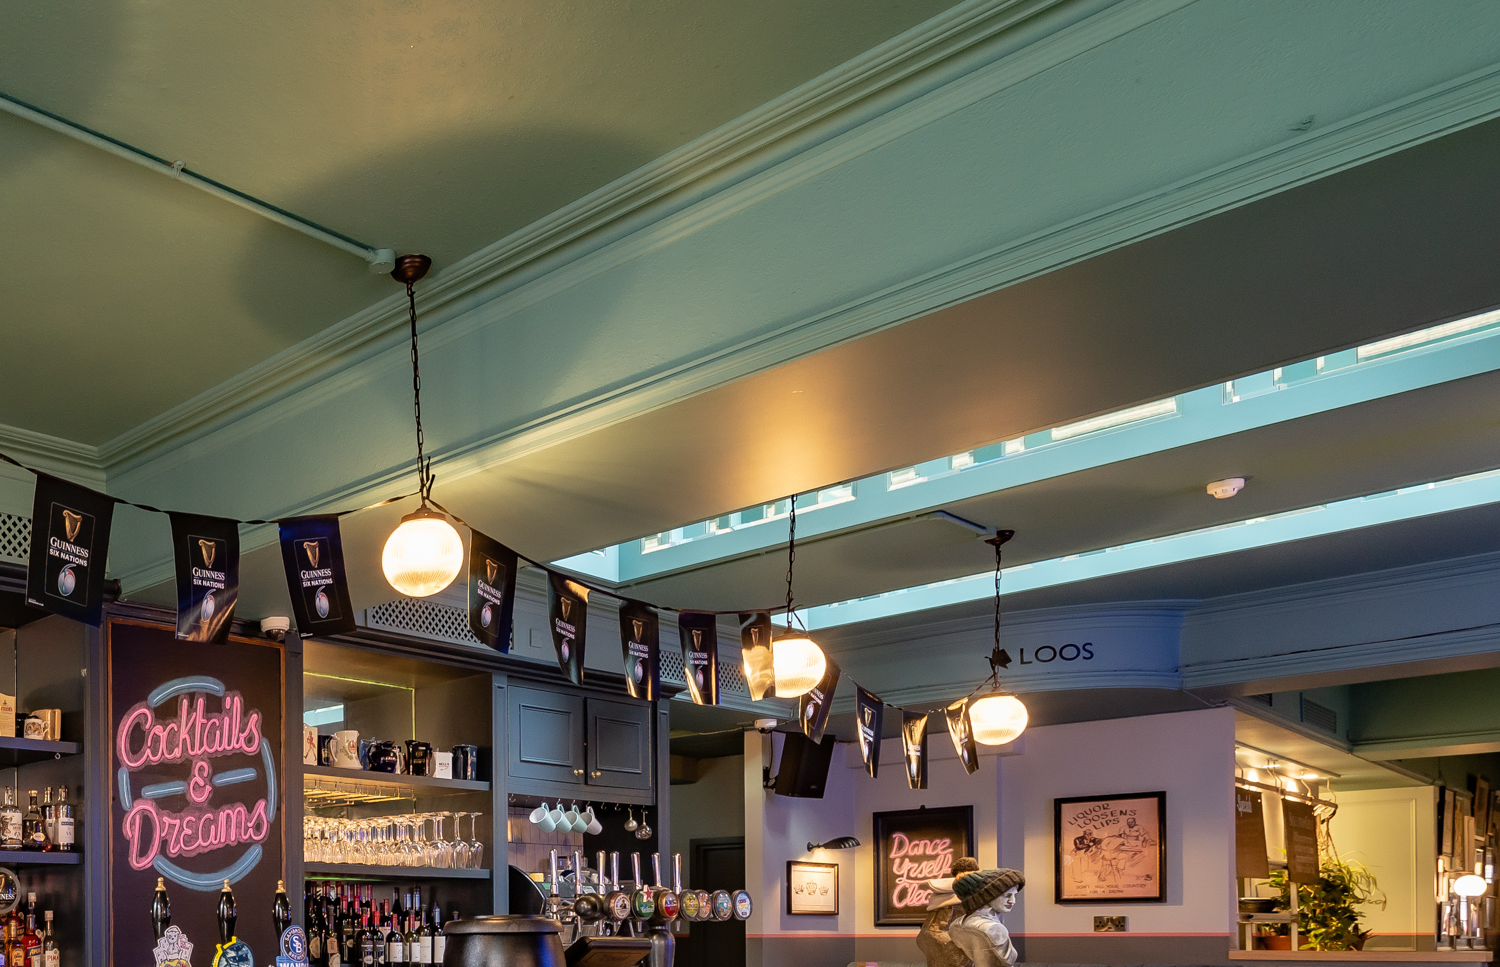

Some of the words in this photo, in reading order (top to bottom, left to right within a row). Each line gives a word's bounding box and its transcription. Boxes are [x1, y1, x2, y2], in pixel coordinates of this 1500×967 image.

[50, 536, 89, 557] GUINNESS
[50, 549, 61, 557] SIX
[61, 553, 88, 567] NATIONS
[193, 567, 225, 581] GUINNESS
[301, 568, 331, 579] GUINNESS
[311, 578, 333, 586] NATIONS
[203, 580, 224, 589] NATIONS
[477, 580, 501, 598] GUINNESS
[555, 618, 576, 633] GUINNESS
[628, 641, 648, 652] GUINNESS
[1020, 642, 1094, 664] LOOS
[119, 692, 261, 769] Cocktails
[189, 760, 213, 803] &
[1068, 803, 1111, 826] LIQUOR
[1077, 809, 1137, 829] LOOSENS
[1093, 818, 1120, 830] LIPS
[125, 800, 269, 869] Dreams
[889, 833, 954, 859] Dance
